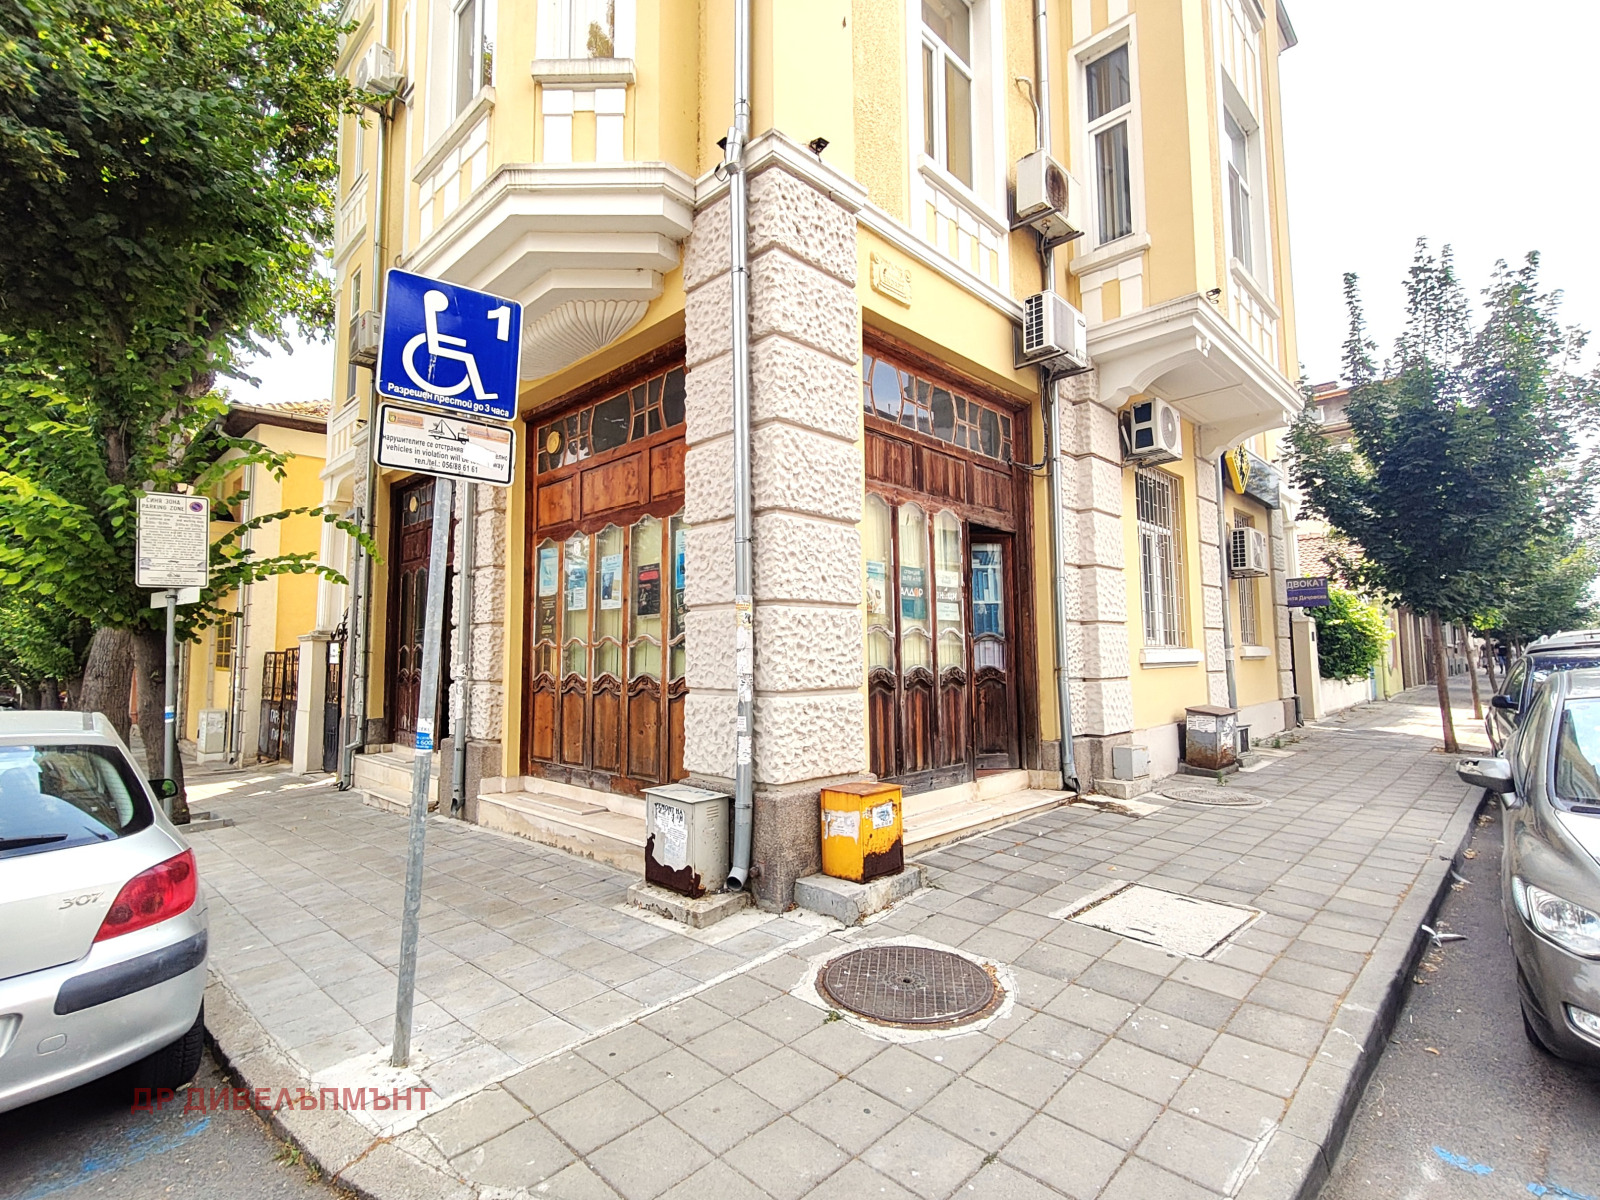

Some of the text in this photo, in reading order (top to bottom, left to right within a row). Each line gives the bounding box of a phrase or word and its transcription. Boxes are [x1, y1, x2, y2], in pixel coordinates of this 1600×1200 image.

[487, 305, 511, 342] 1
[388, 382, 509, 417] Разрешен престой до 3 часа
[382, 434, 425, 447] нарушителите
[386, 444, 413, 453] vehicles
[414, 447, 420, 455] in
[422, 449, 449, 459] violation
[463, 464, 469, 472] 61
[1287, 579, 1324, 589] ДВОКАТ
[58, 891, 104, 910] 307
